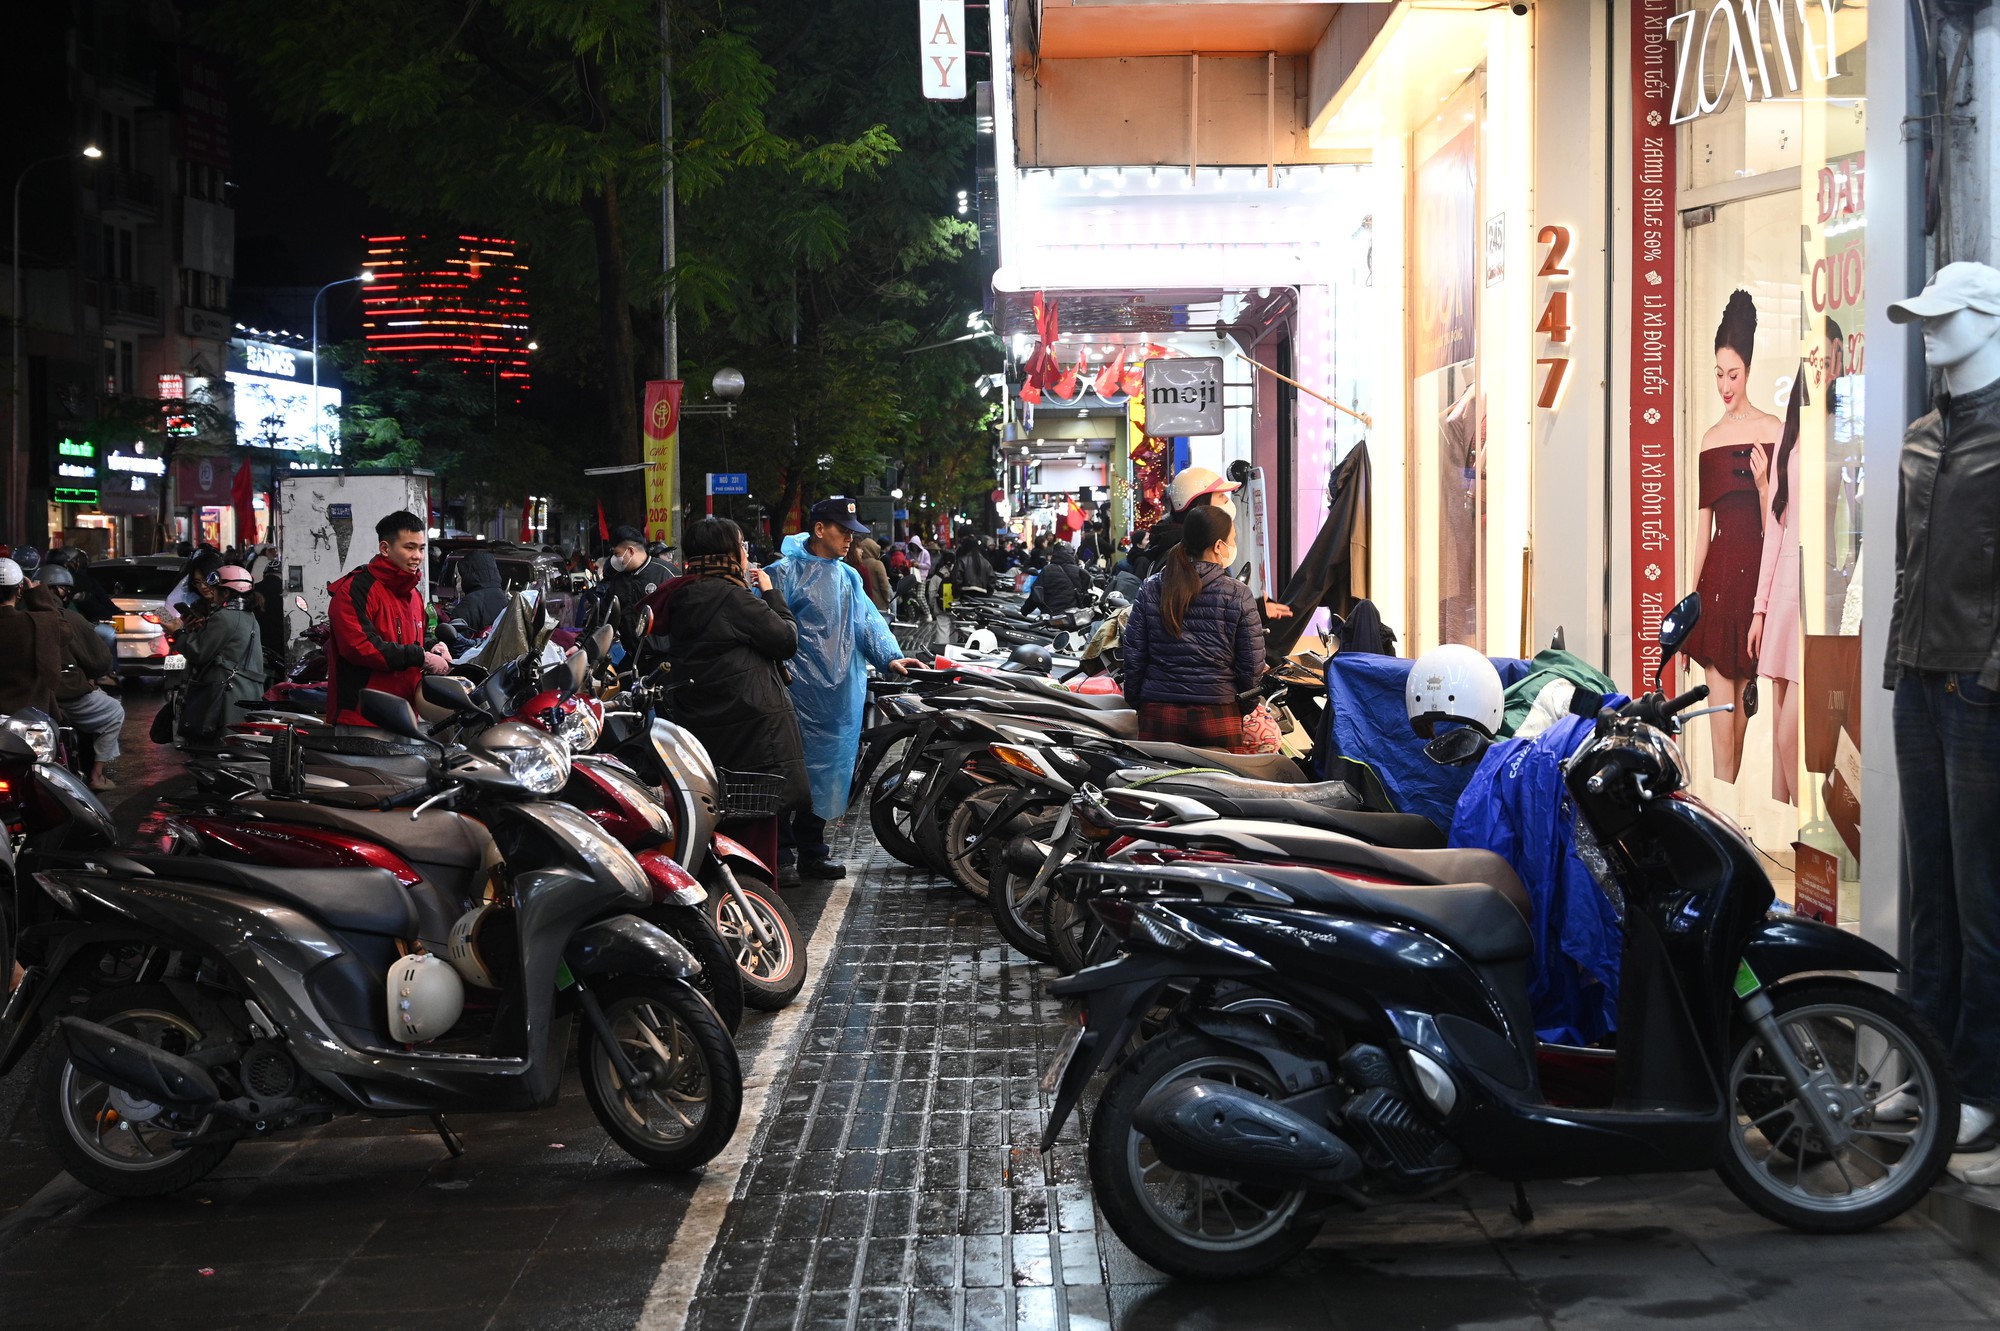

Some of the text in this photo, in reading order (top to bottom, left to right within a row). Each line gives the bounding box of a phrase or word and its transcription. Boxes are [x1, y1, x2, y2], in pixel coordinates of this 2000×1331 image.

[929, 0, 958, 87] AY
[1644, 33, 1667, 65] ĐÓN
[1644, 68, 1670, 98] TẾT
[1643, 188, 1664, 226] SALE
[1488, 219, 1503, 254] 245
[1643, 232, 1662, 262] 50%
[1536, 225, 1571, 408] 247
[1643, 294, 1668, 395] LÌ XÌ ĐÓN TẾT
[1152, 380, 1217, 412] moji
[1641, 443, 1669, 551] LÌ XÌ ĐÓN TẾT
[649, 508, 668, 523] 2026
[1427, 684, 1441, 693] Royal
